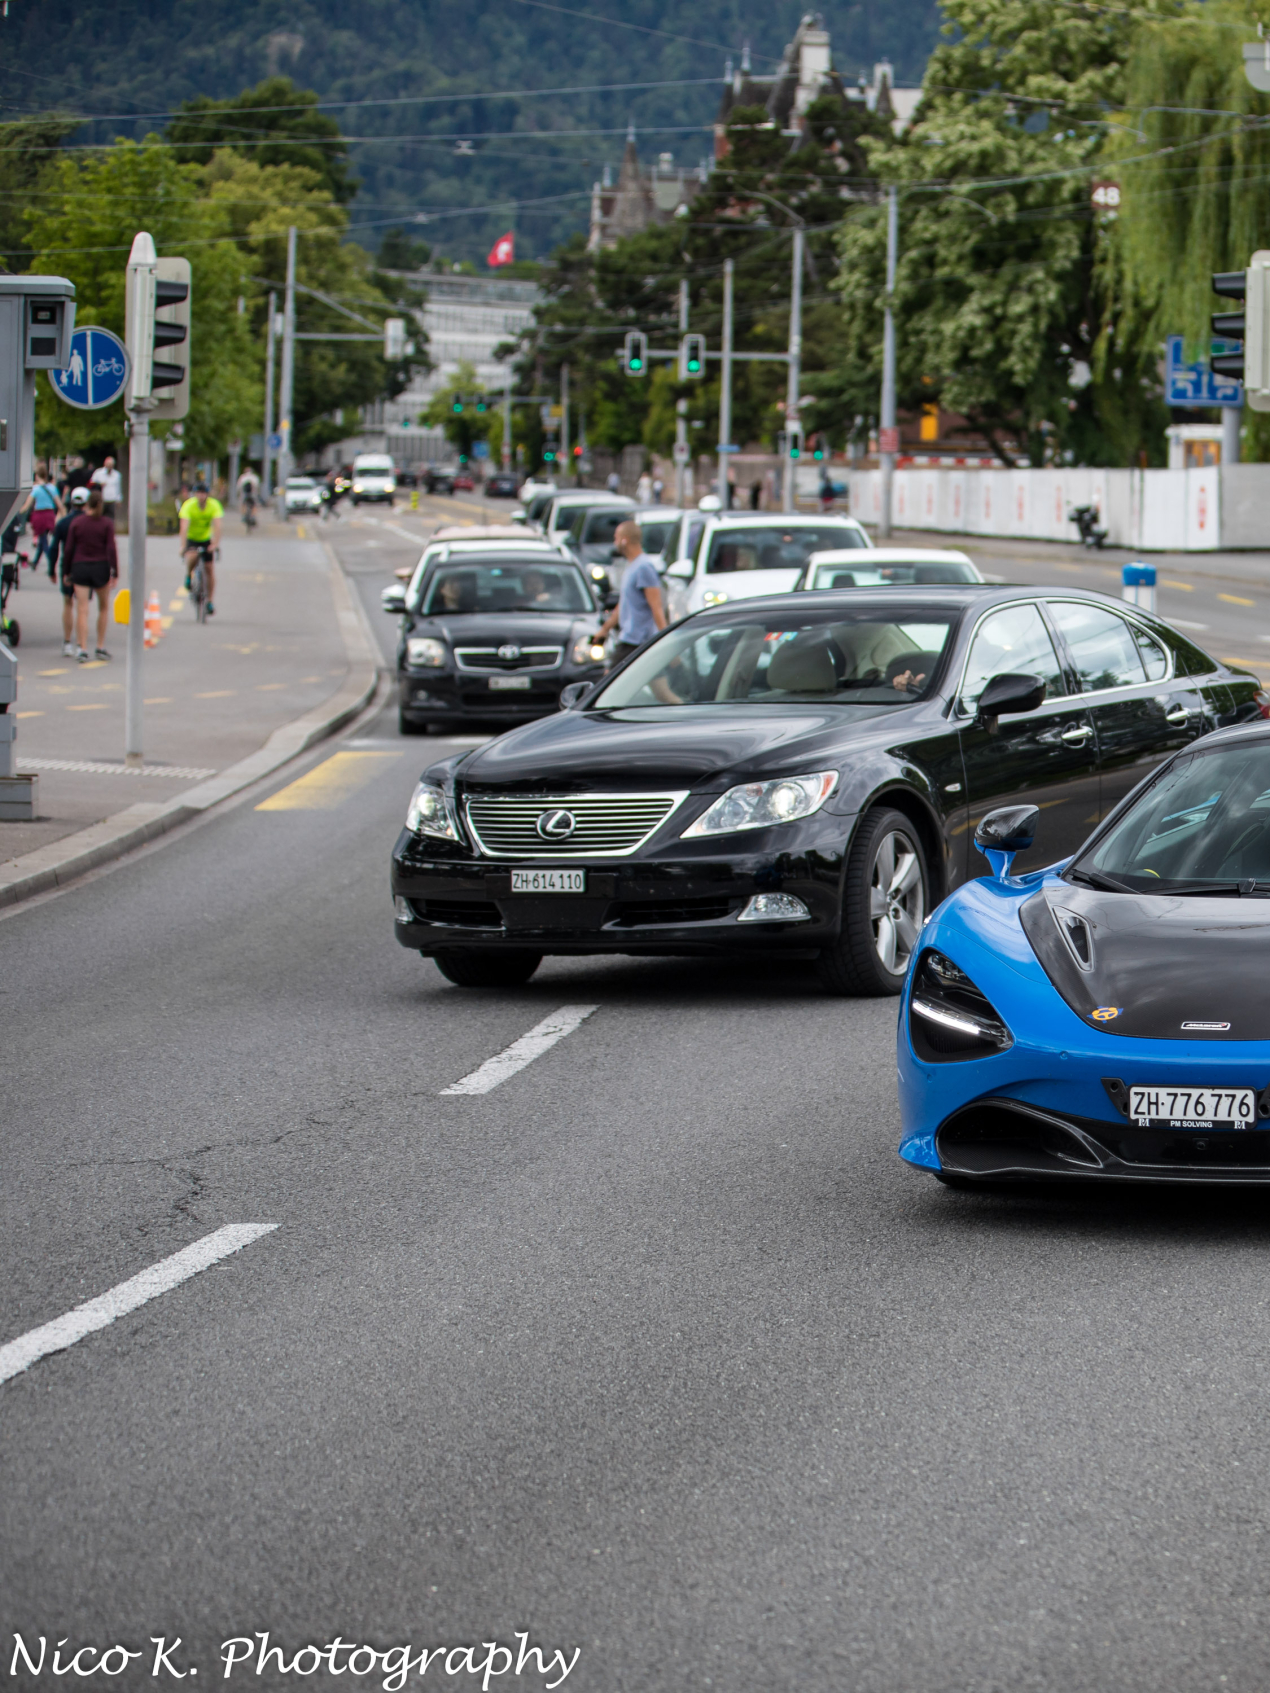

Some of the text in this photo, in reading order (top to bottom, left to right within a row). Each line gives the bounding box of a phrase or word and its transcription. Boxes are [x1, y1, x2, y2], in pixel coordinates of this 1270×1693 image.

[1091, 186, 1121, 206] 48
[1170, 1120, 1213, 1128] PM SOLVING
